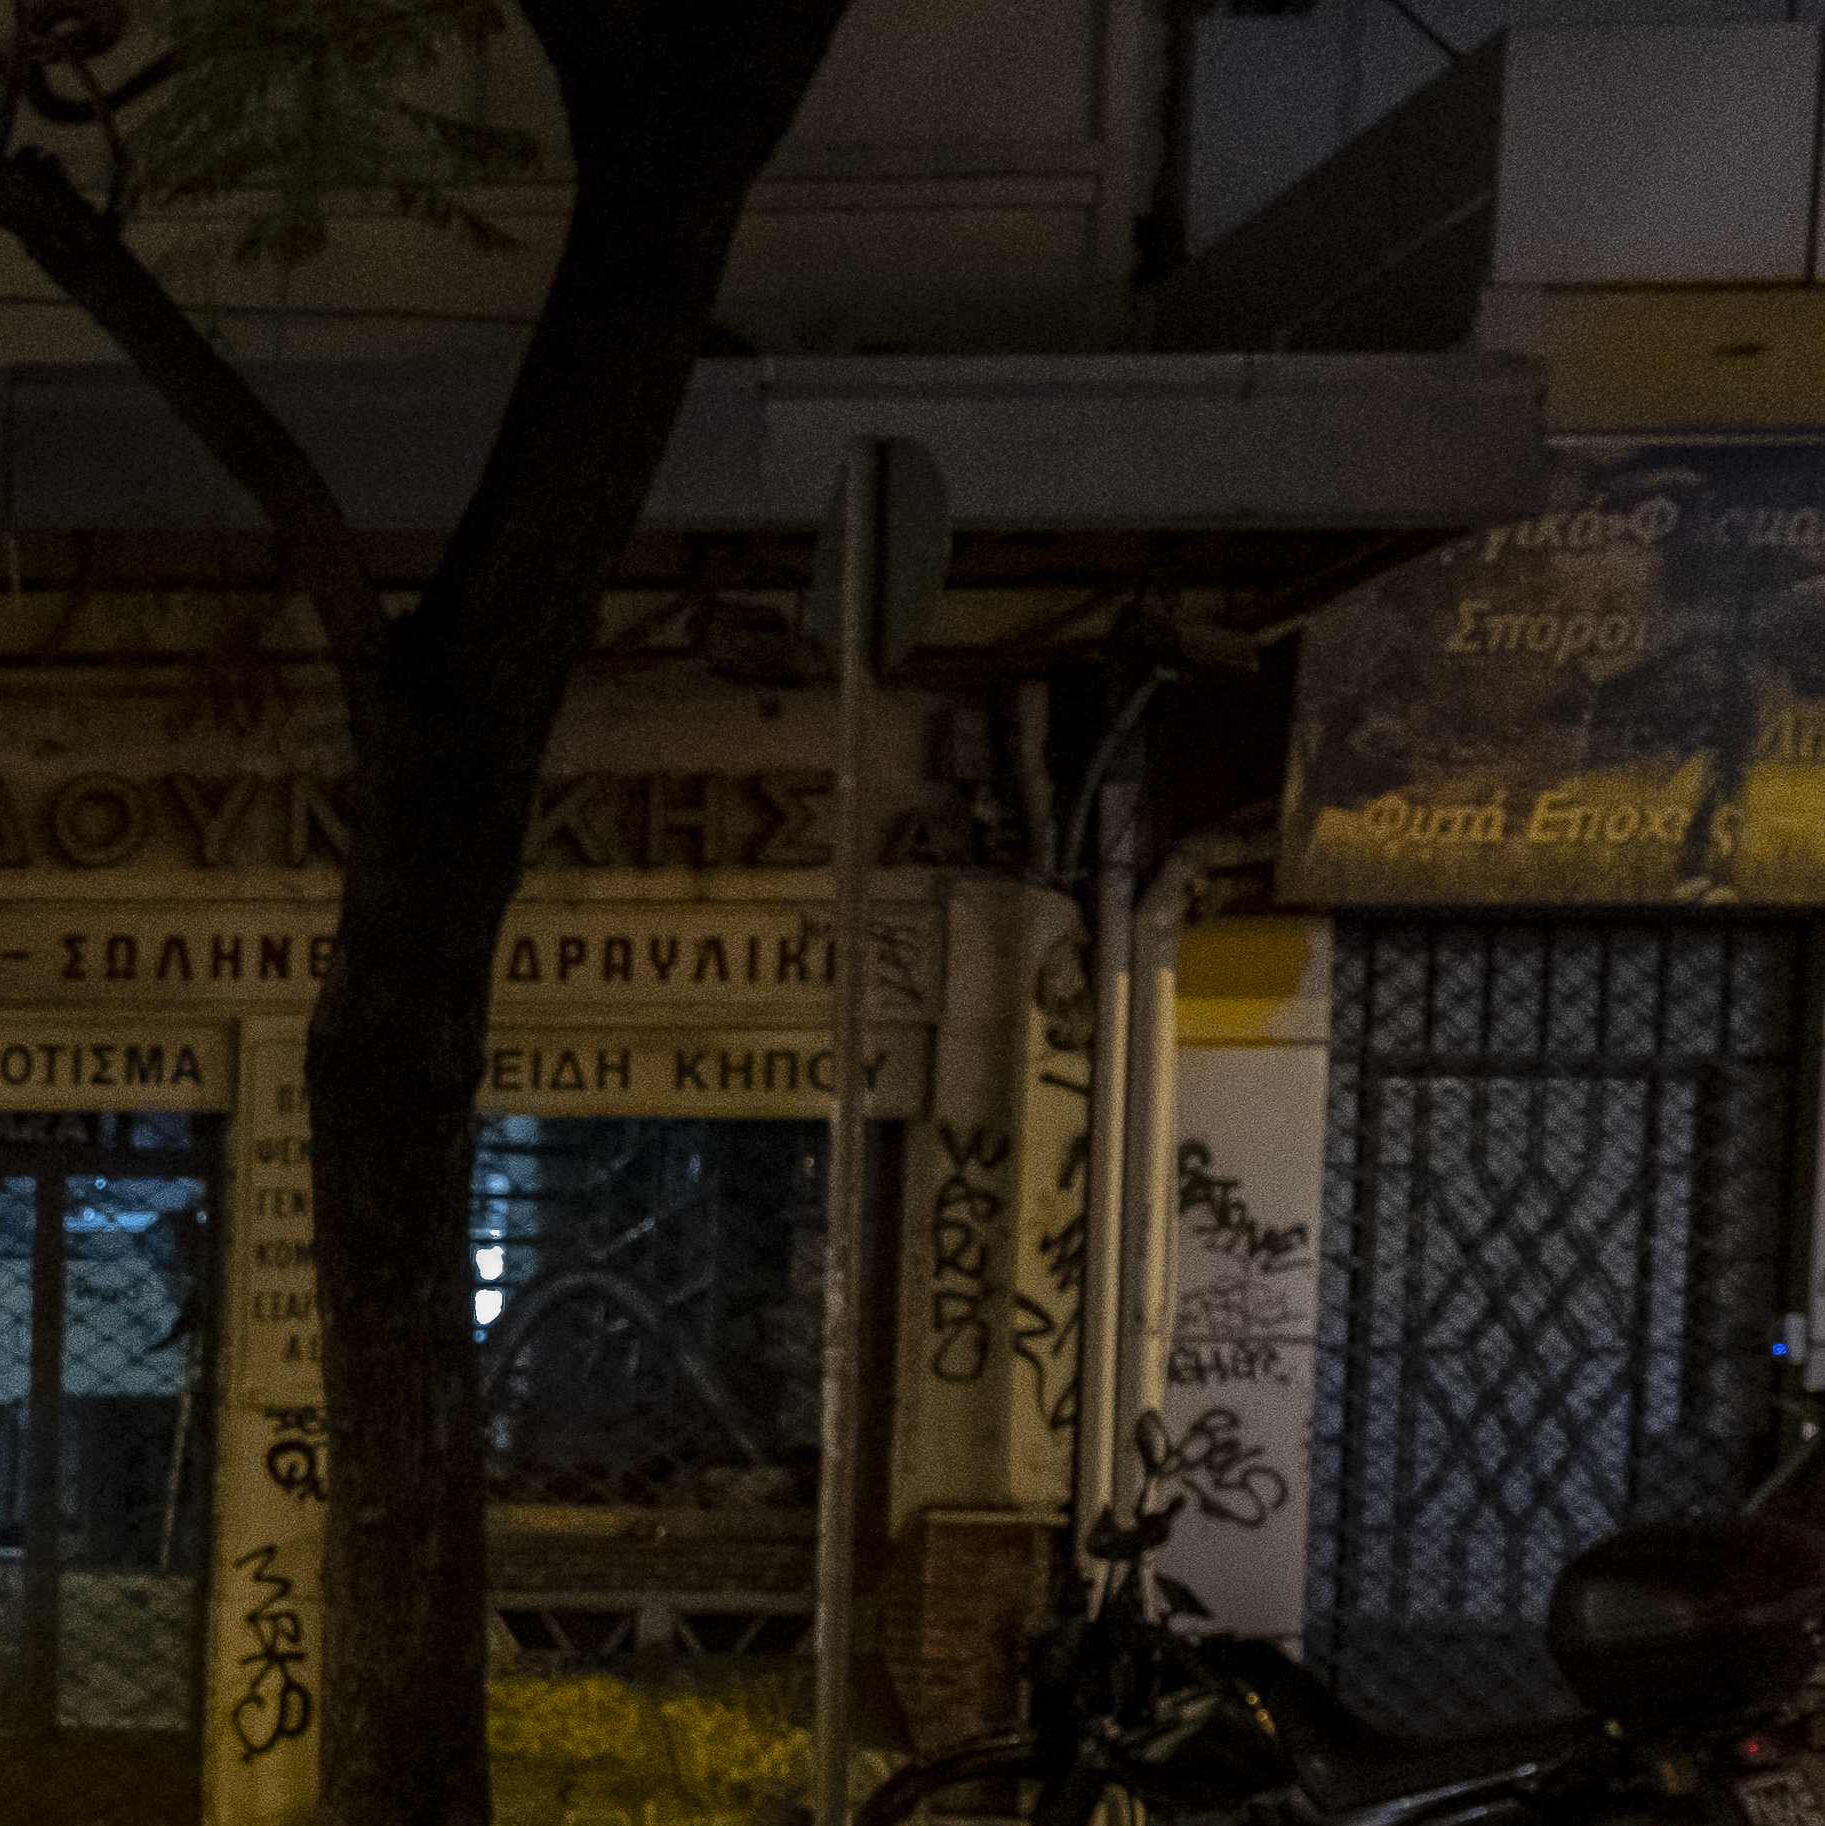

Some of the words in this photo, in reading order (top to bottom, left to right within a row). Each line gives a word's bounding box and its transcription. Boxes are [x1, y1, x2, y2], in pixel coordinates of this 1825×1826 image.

[60, 932, 339, 982] ΣΩΛΗΝΕ
[506, 934, 838, 984] ΔΡΑΥΛΙΚ
[492, 1048, 631, 1091] ΕΙΔΗ
